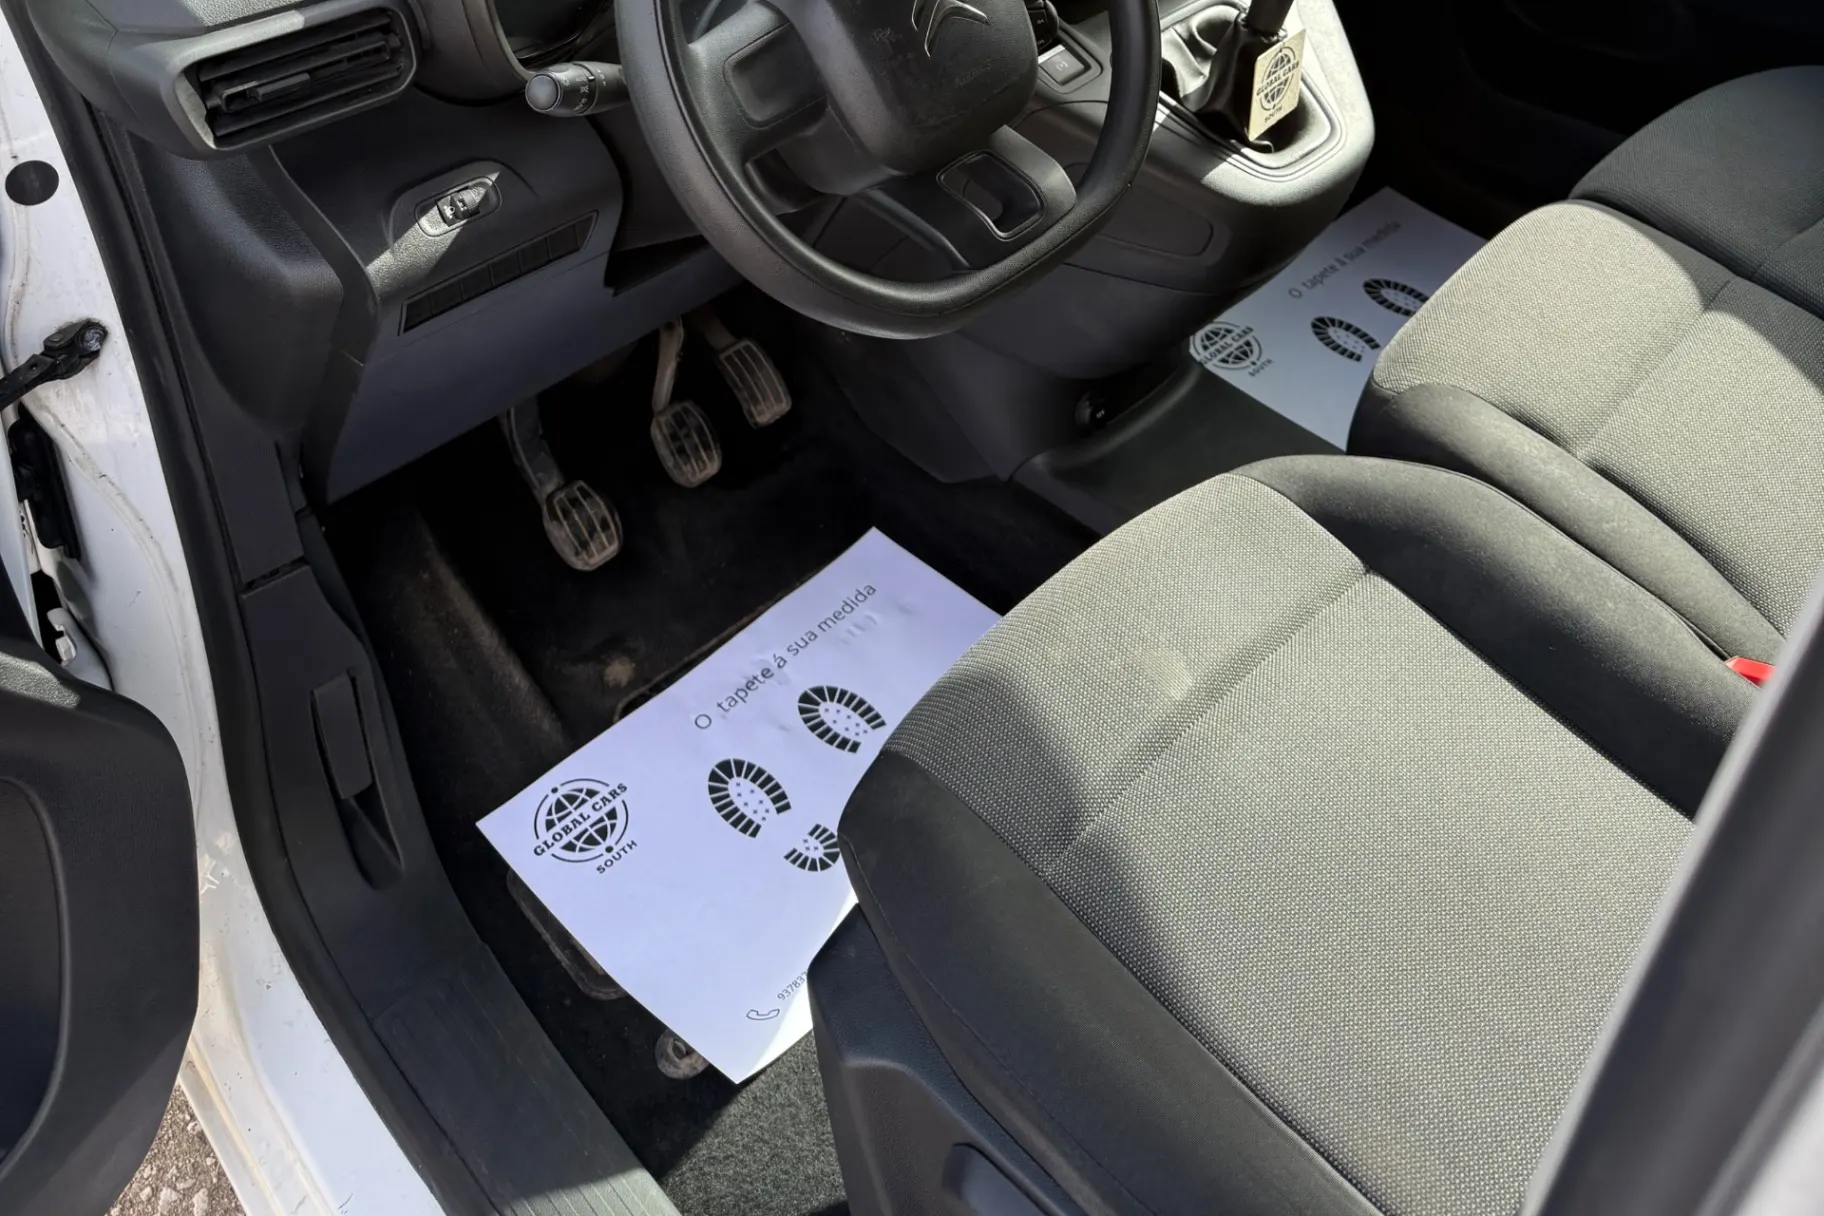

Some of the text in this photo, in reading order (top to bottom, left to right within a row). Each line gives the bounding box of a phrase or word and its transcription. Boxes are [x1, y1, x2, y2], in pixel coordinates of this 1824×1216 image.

[1256, 75, 1281, 97] GLOBAL
[1302, 264, 1340, 290] tapete
[694, 713, 712, 730] O
[716, 667, 775, 713] tapete
[786, 630, 818, 656] sua
[817, 584, 877, 633] medida
[533, 783, 628, 857] GLOBAL CARS
[596, 840, 638, 874] SOUTH
